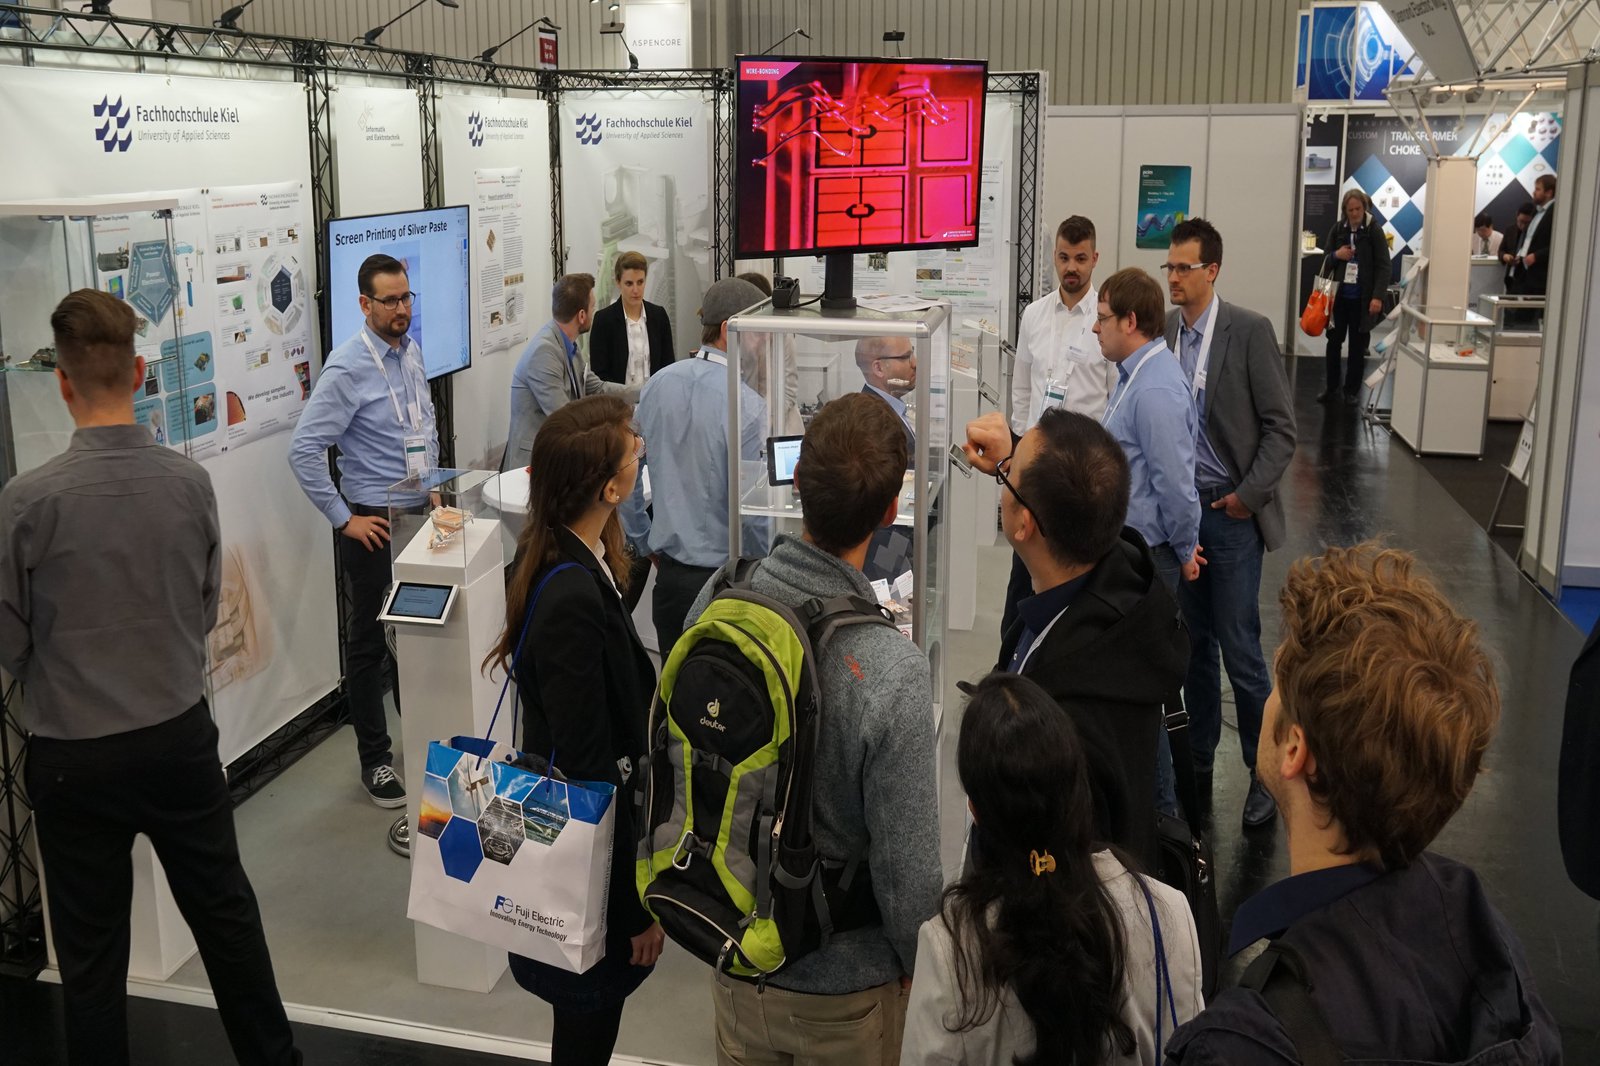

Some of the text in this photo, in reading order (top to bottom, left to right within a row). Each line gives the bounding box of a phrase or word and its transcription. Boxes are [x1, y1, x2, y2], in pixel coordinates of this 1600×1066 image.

[632, 38, 681, 47] ASPENCORE
[745, 67, 780, 75] WIRE-BONDING
[136, 105, 240, 123] Fachhochschule Kiel
[485, 117, 529, 129] Fachhochschule Kiel
[606, 116, 693, 128] Fachhochschule Kiel
[138, 129, 230, 143] University of Applied Sciences
[606, 131, 684, 141] University of Applied Sciences
[1347, 131, 1378, 139] CUSTOM
[1389, 145, 1422, 155] CHOKE
[335, 221, 448, 246] Screen Printing of Silver Paste
[700, 716, 727, 732] deuter
[515, 905, 564, 928] Fuji Electric
[490, 909, 567, 942] Innovating Energy Technology
